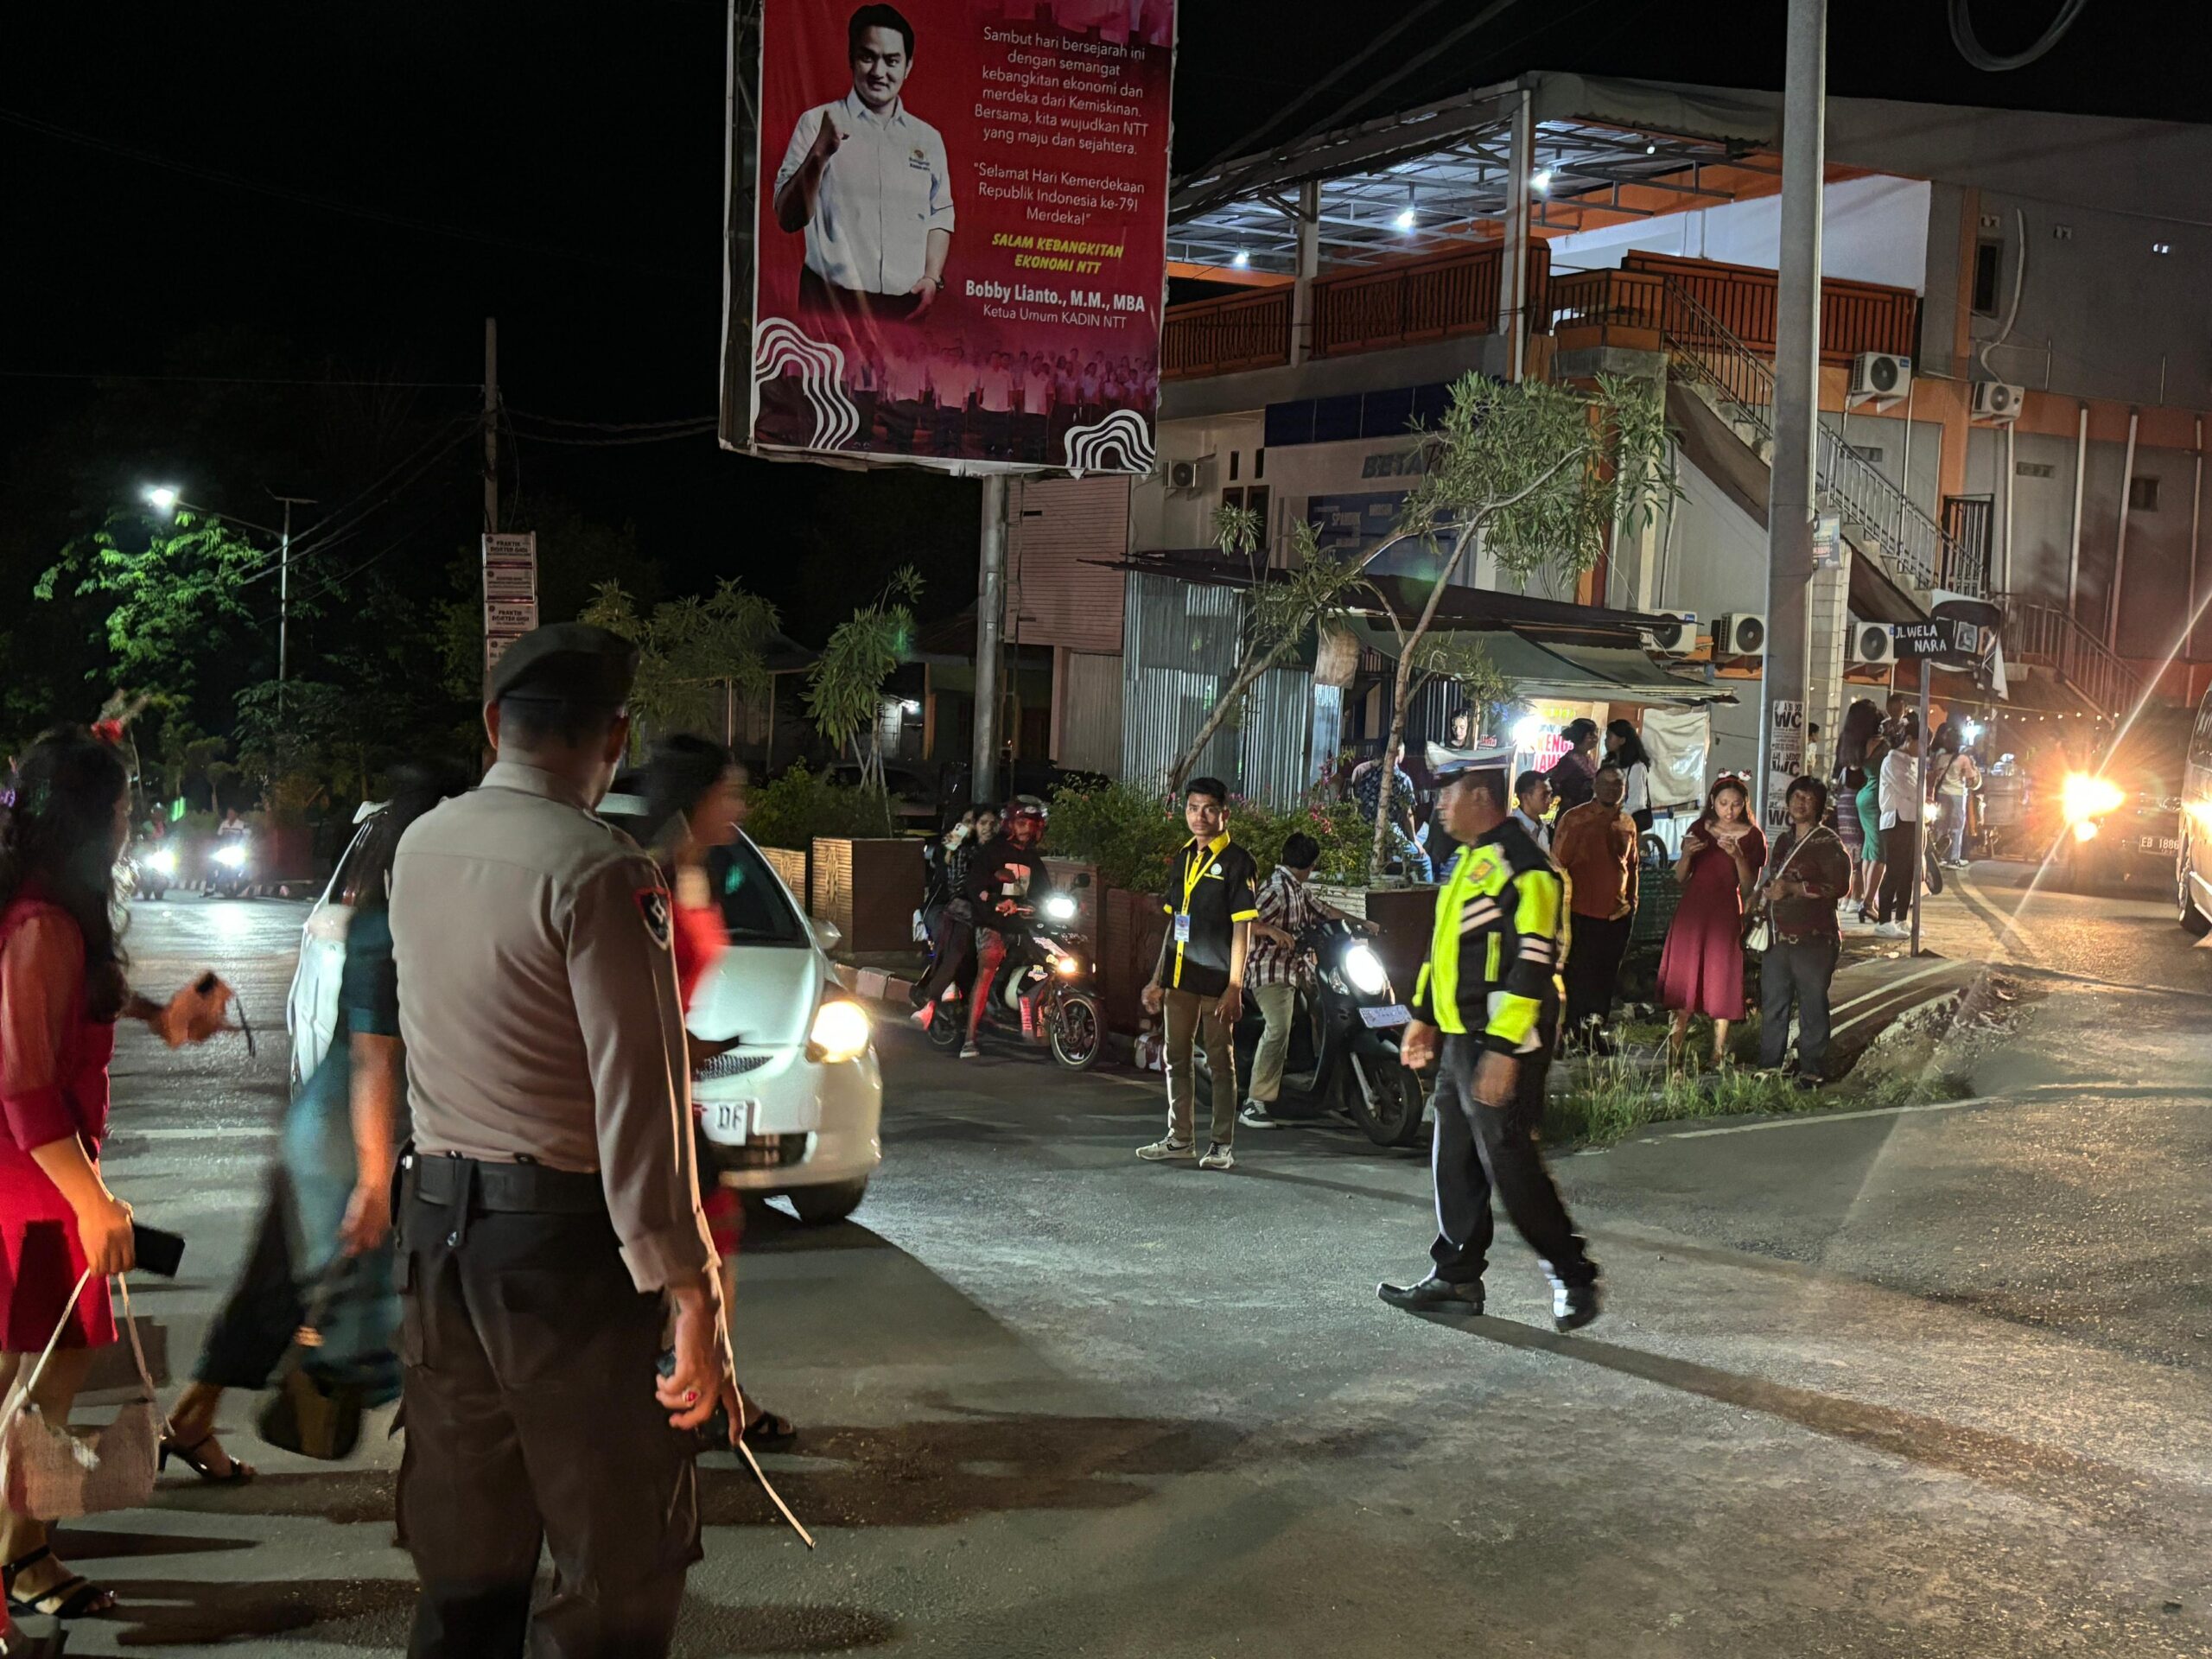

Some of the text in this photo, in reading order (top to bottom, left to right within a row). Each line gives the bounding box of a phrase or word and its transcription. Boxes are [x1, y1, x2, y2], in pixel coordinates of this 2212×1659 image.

[983, 26, 1146, 60] Sambut hari bersejarah ini
[1007, 51, 1120, 78] dengan semangat
[982, 66, 1143, 99] kebangkitan ekonomi dan
[982, 88, 1141, 118] merdeka dari Kemiskinan.
[975, 104, 1148, 137] Bersama, kita wujudkan NTT
[983, 127, 1137, 156] yang maju dan sejahtera.
[974, 162, 1145, 194] "Selamat Hari Kemerdekaan
[978, 182, 1138, 213] Republik Indonesia ke-79!
[992, 233, 1124, 258] SALAM KEBANGKITAN
[1014, 254, 1102, 274] EKONOMI NTT
[965, 279, 1146, 312] Bobby Lianto., M.M., MBA
[983, 304, 1127, 329] Ketua Umum KADIN NTT
[1914, 639, 1948, 653] NARA
[1775, 711, 1802, 728] WC
[1772, 760, 1800, 777] WC
